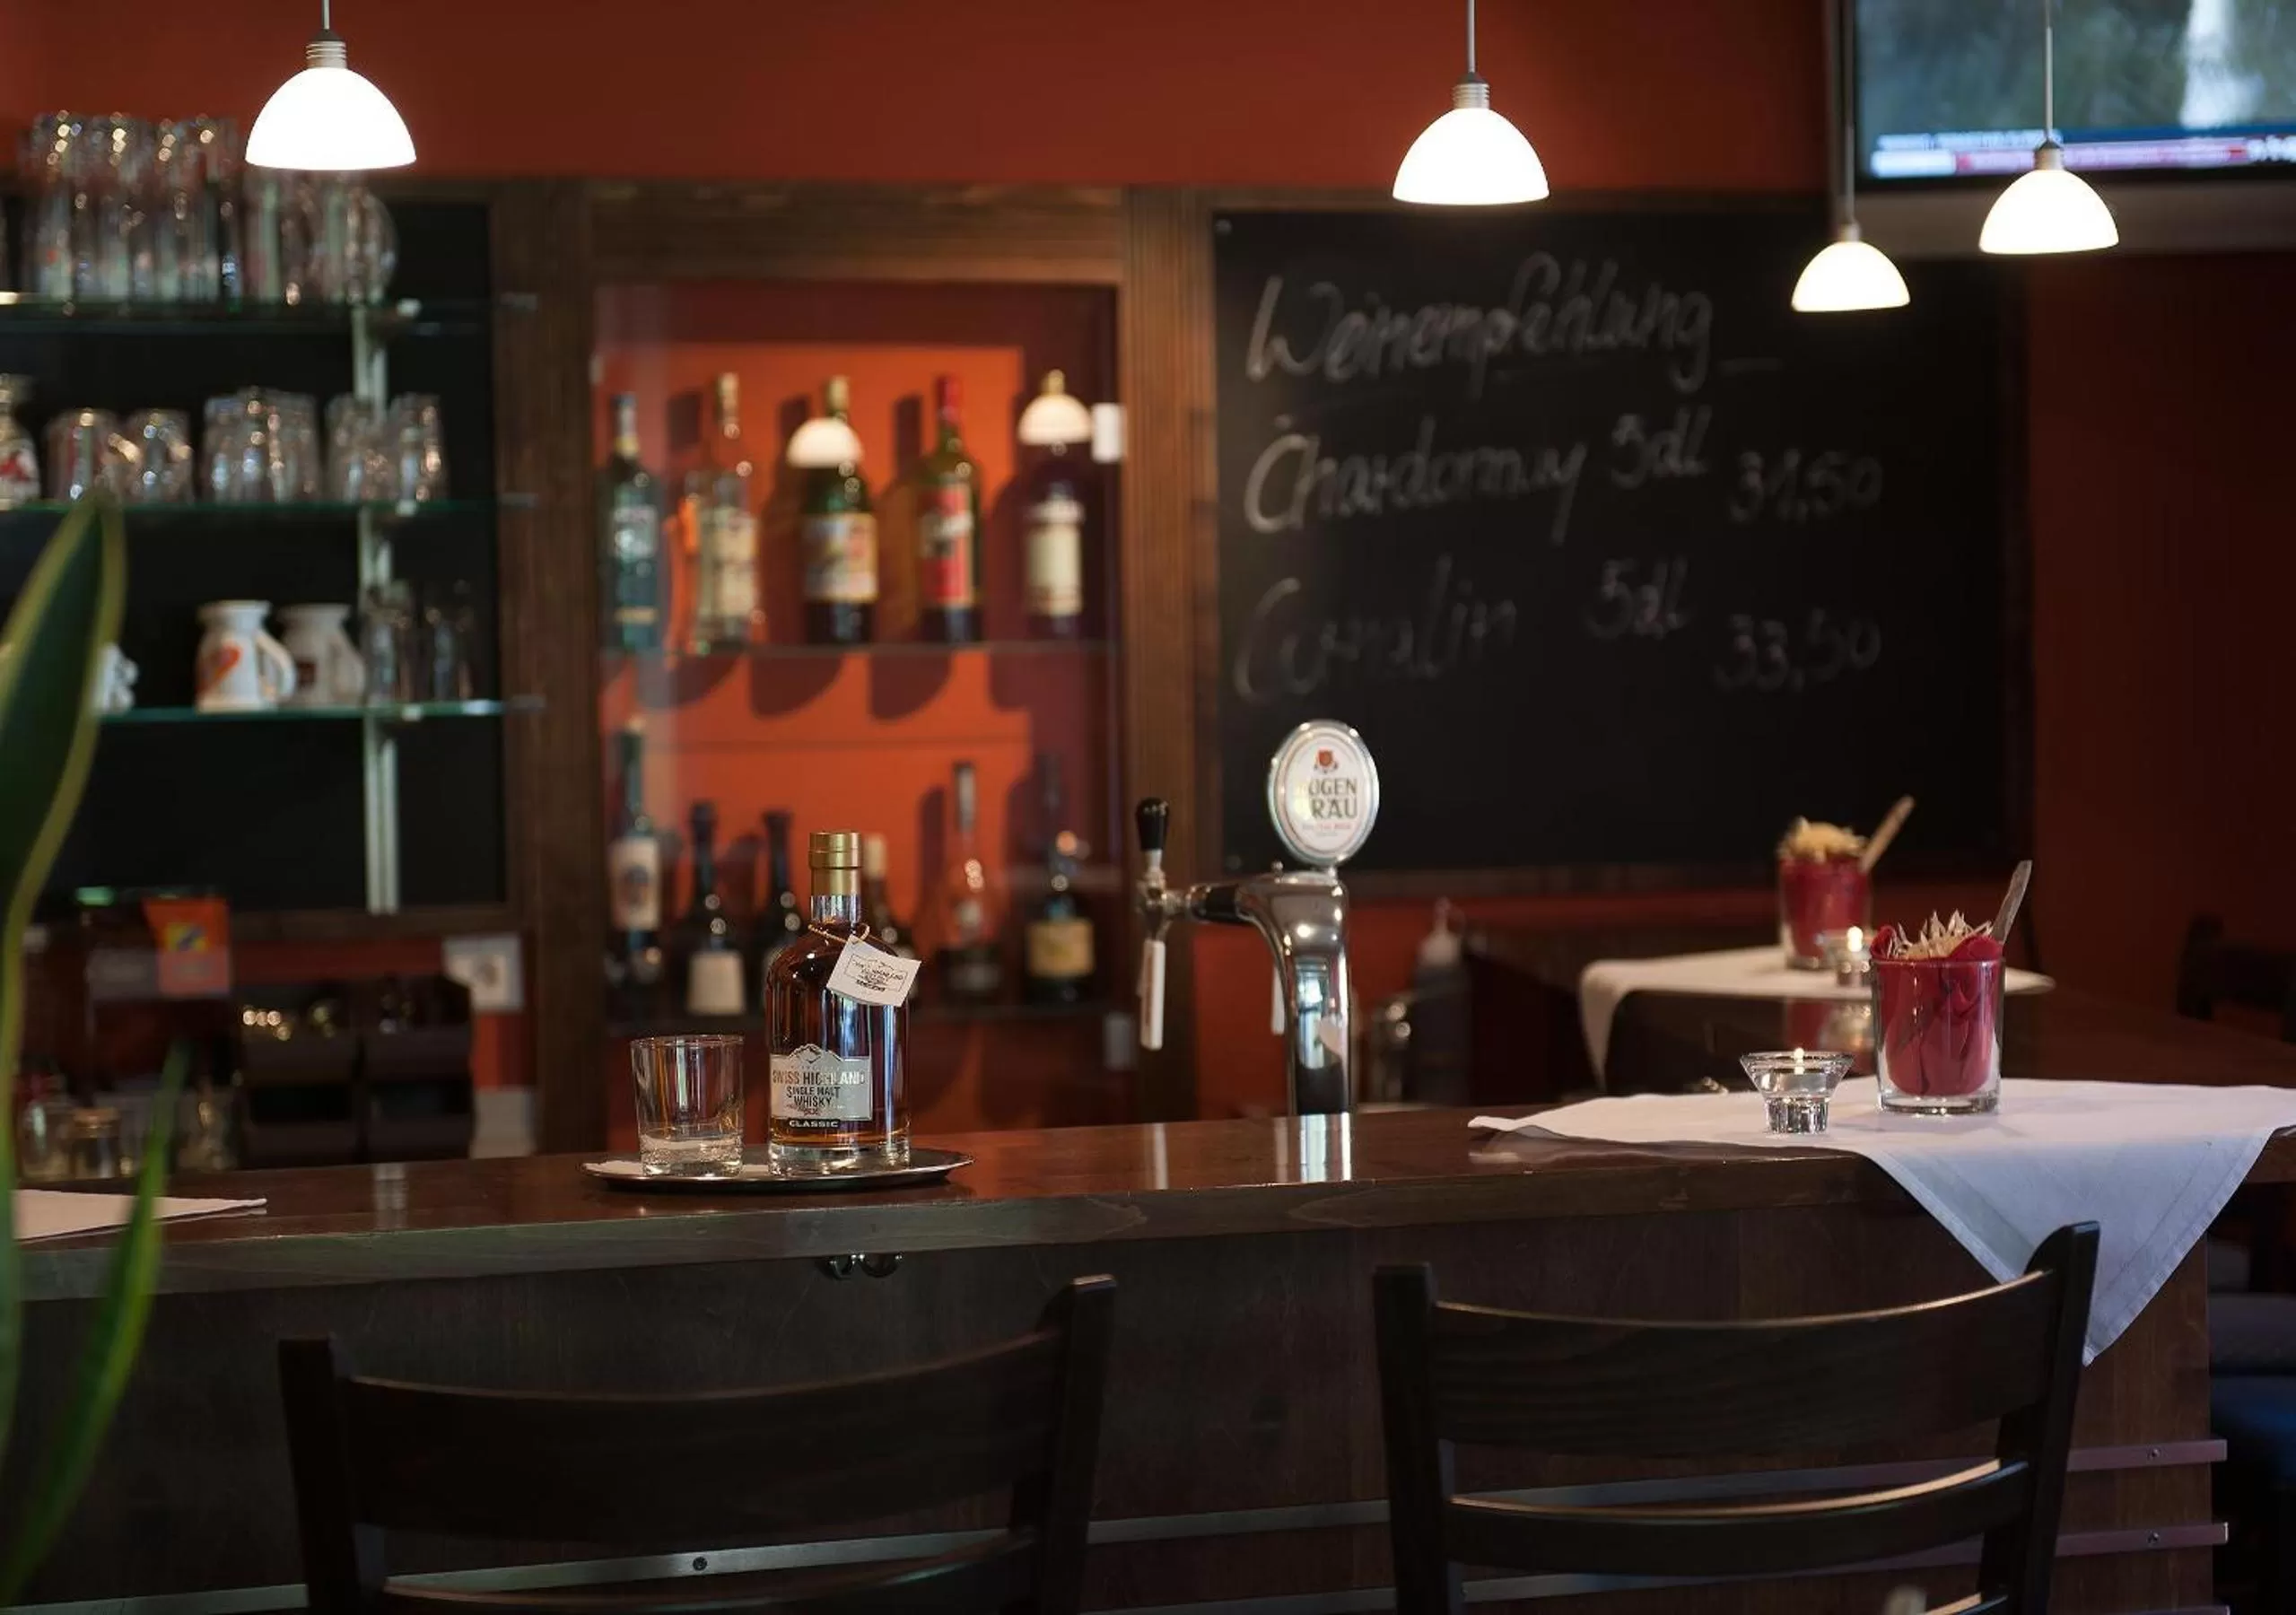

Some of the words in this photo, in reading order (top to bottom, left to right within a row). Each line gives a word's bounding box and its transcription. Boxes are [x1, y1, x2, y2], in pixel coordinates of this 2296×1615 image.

[1579, 554, 1692, 639] 5dl
[787, 1086, 815, 1097] SINGLE
[817, 1087, 841, 1098] MALT
[794, 1096, 832, 1108] WHISKY
[789, 1120, 839, 1128] CLASSIC
